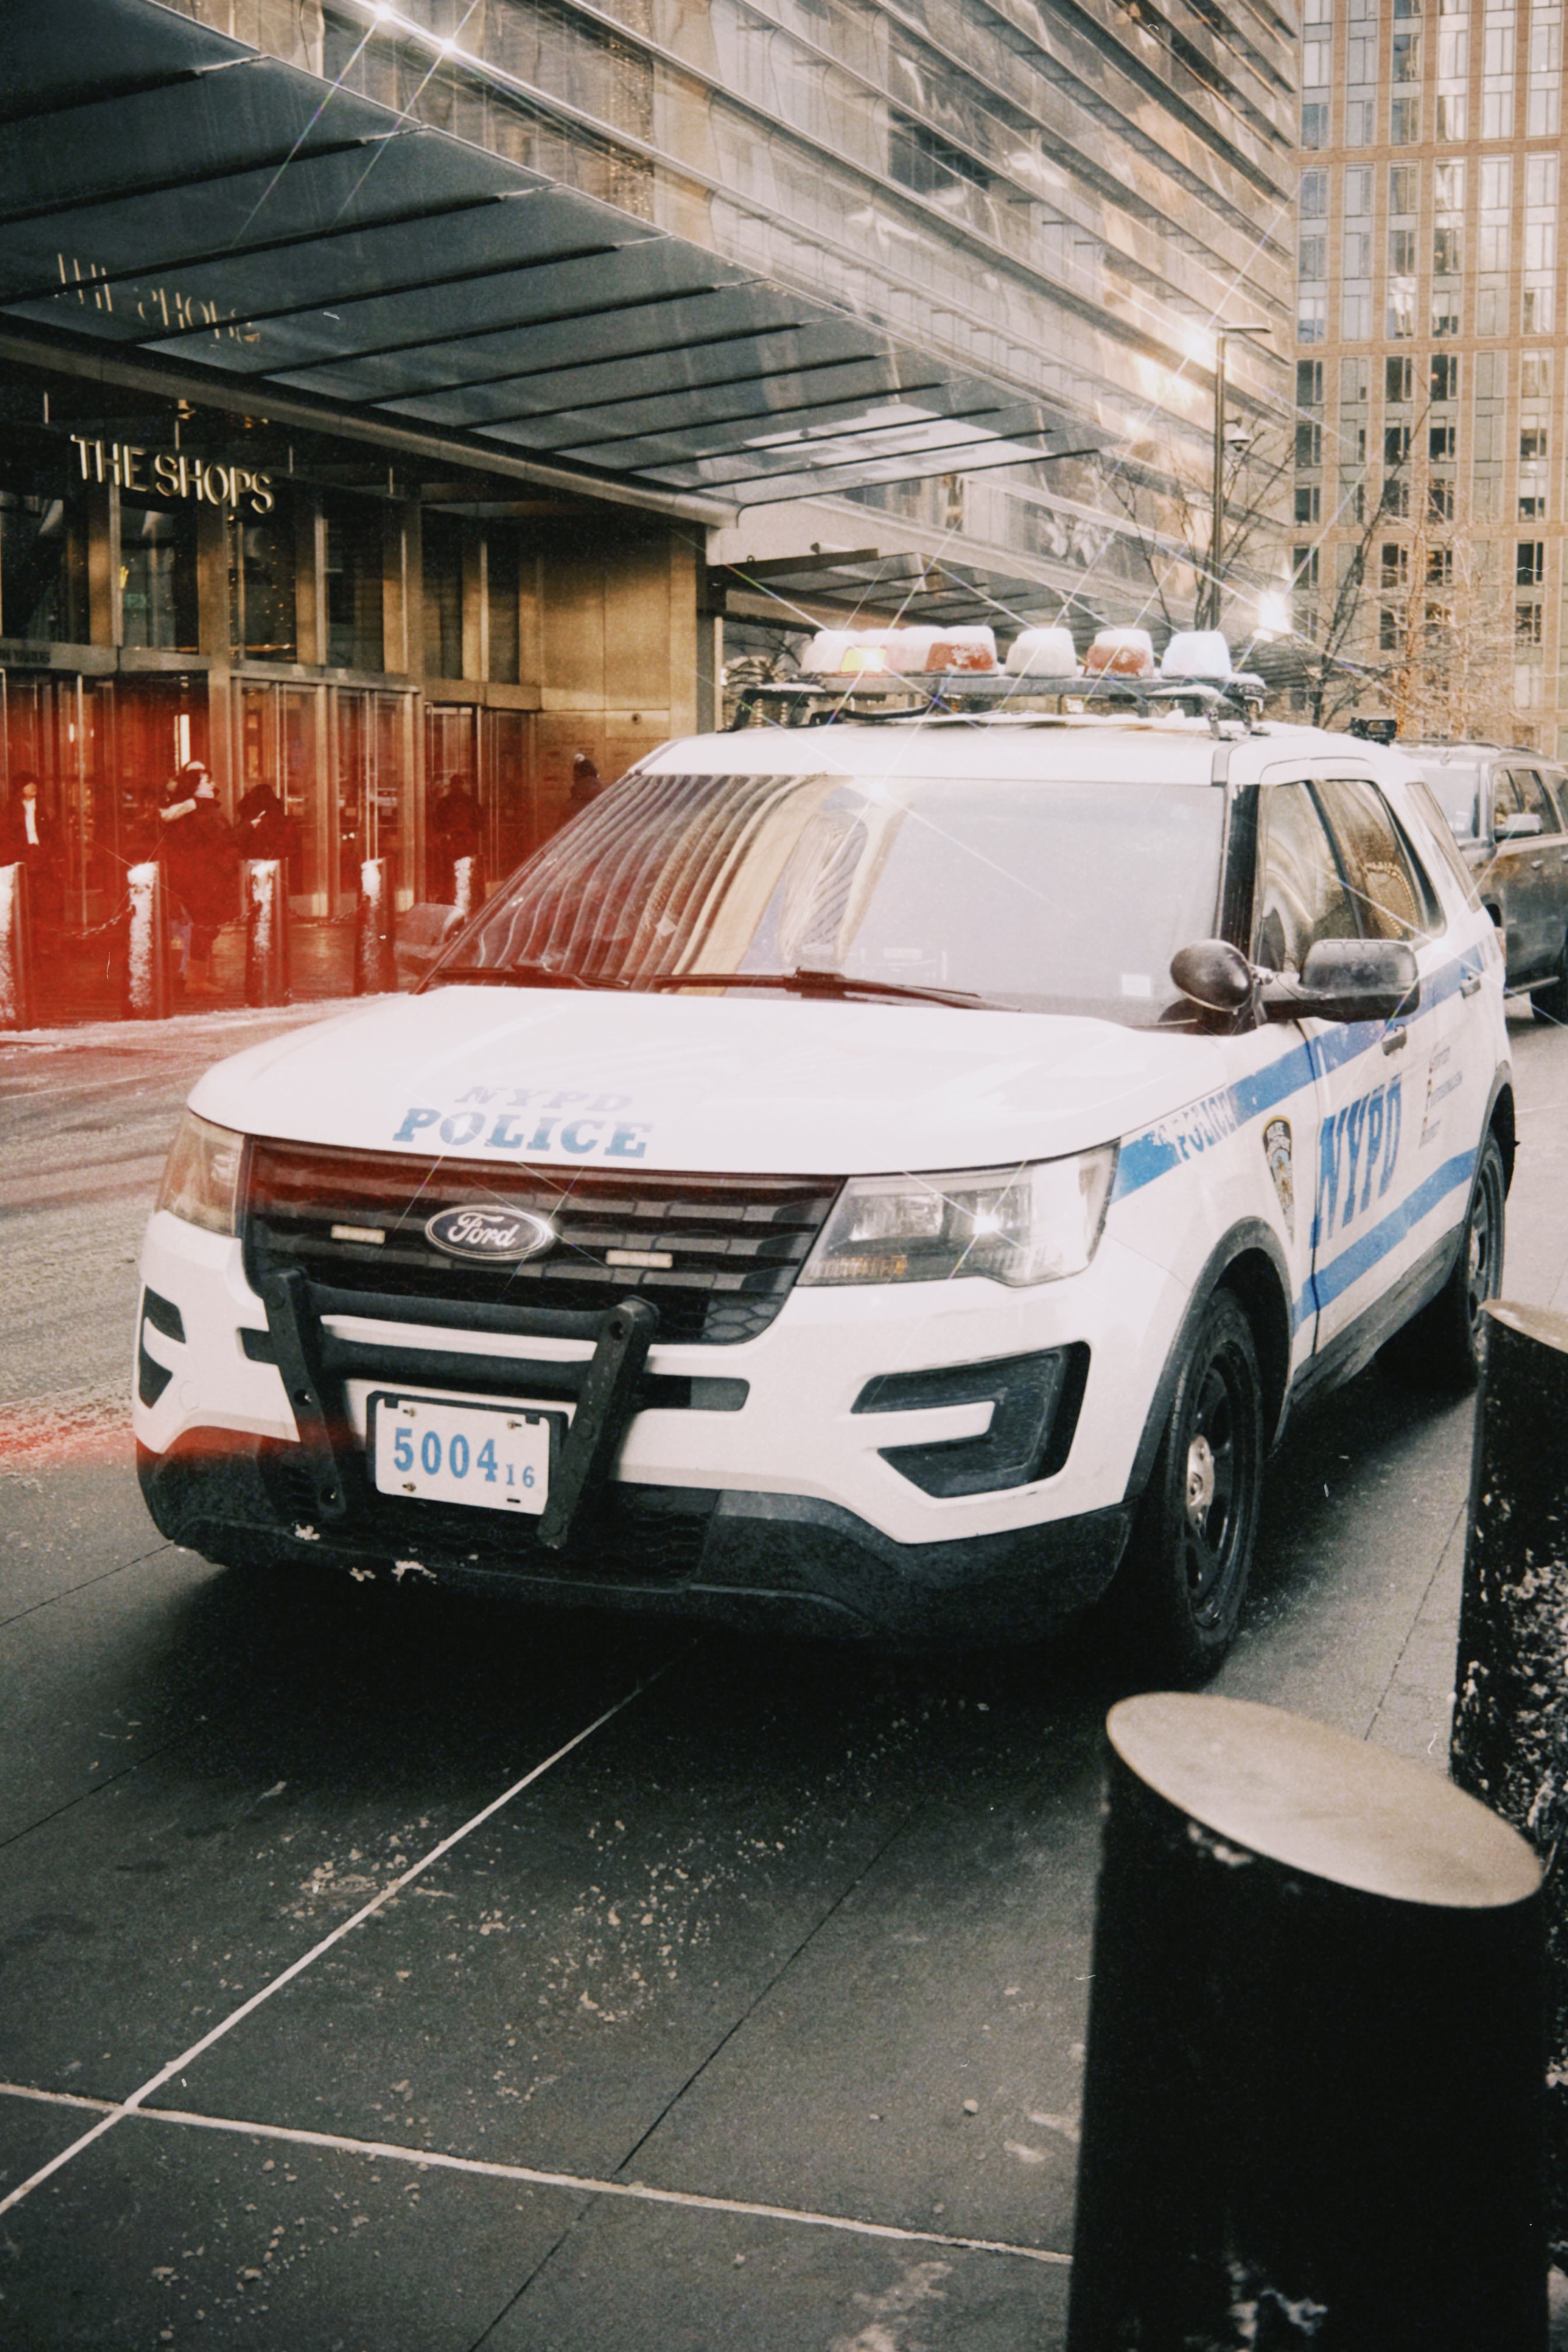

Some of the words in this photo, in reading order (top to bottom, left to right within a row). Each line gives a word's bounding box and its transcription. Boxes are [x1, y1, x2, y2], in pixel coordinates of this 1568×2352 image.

[70, 433, 149, 492] THE
[154, 453, 275, 514] SHOPS
[454, 1086, 634, 1112] NYPD
[1172, 1091, 1237, 1161] POLICE
[392, 1107, 654, 1158] POLICE
[1309, 1072, 1402, 1250] NYPD
[447, 1211, 520, 1248] Ford
[393, 1427, 498, 1482] 5004
[505, 1464, 536, 1489] 16
